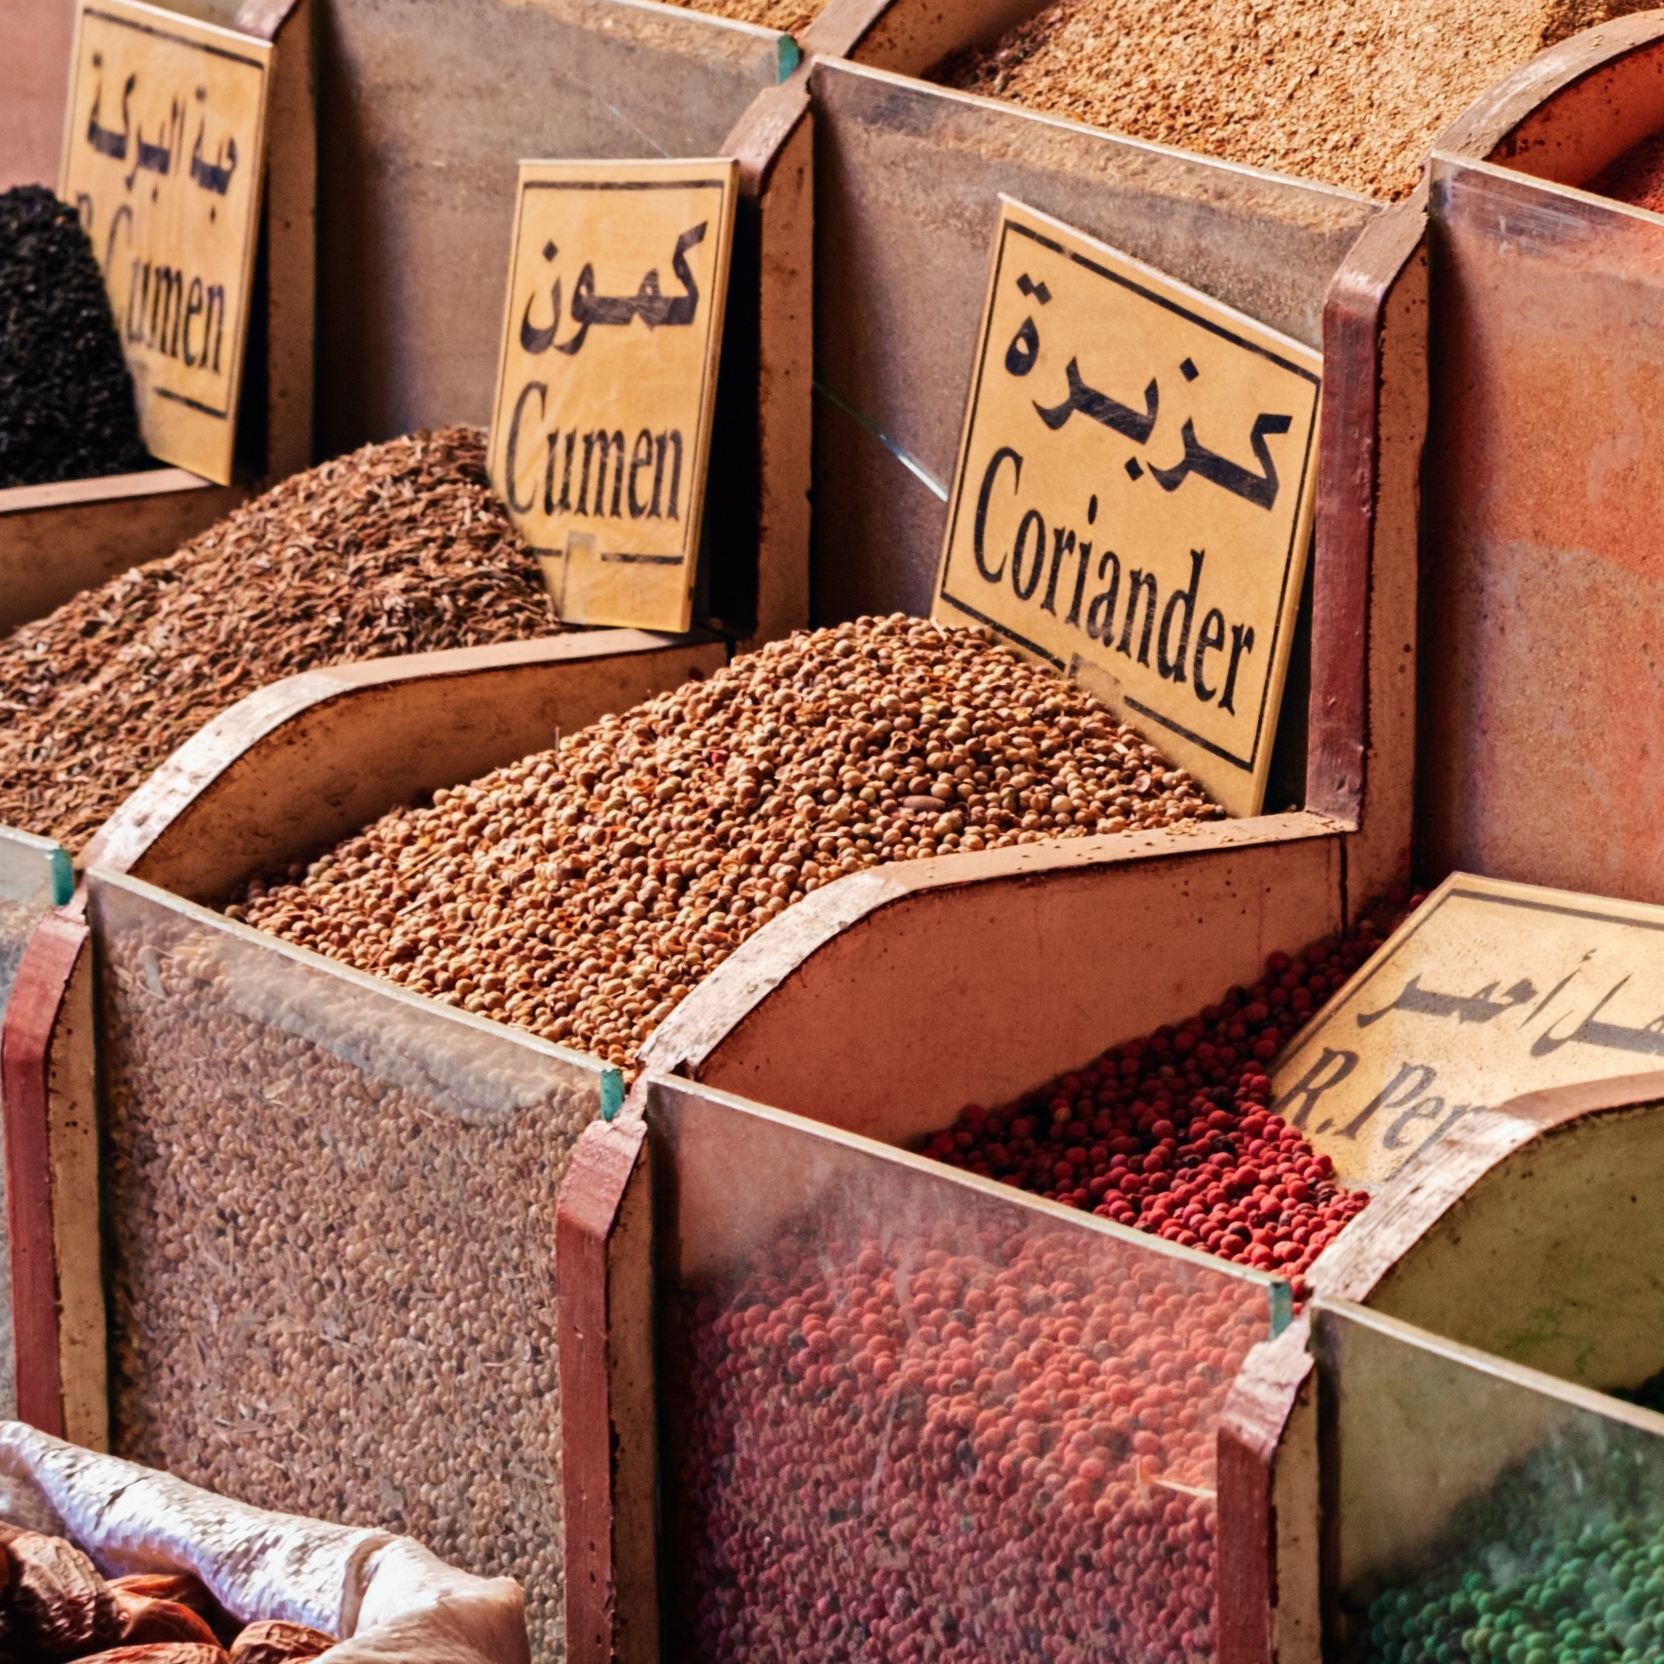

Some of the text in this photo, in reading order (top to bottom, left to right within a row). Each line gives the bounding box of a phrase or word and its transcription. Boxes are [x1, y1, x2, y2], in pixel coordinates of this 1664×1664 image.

[520, 220, 708, 356] كمون
[505, 381, 683, 522] Cumen
[1004, 274, 1292, 510] كزبرة
[973, 446, 1254, 715] Coriander
[1357, 948, 1597, 1029] أحمر
